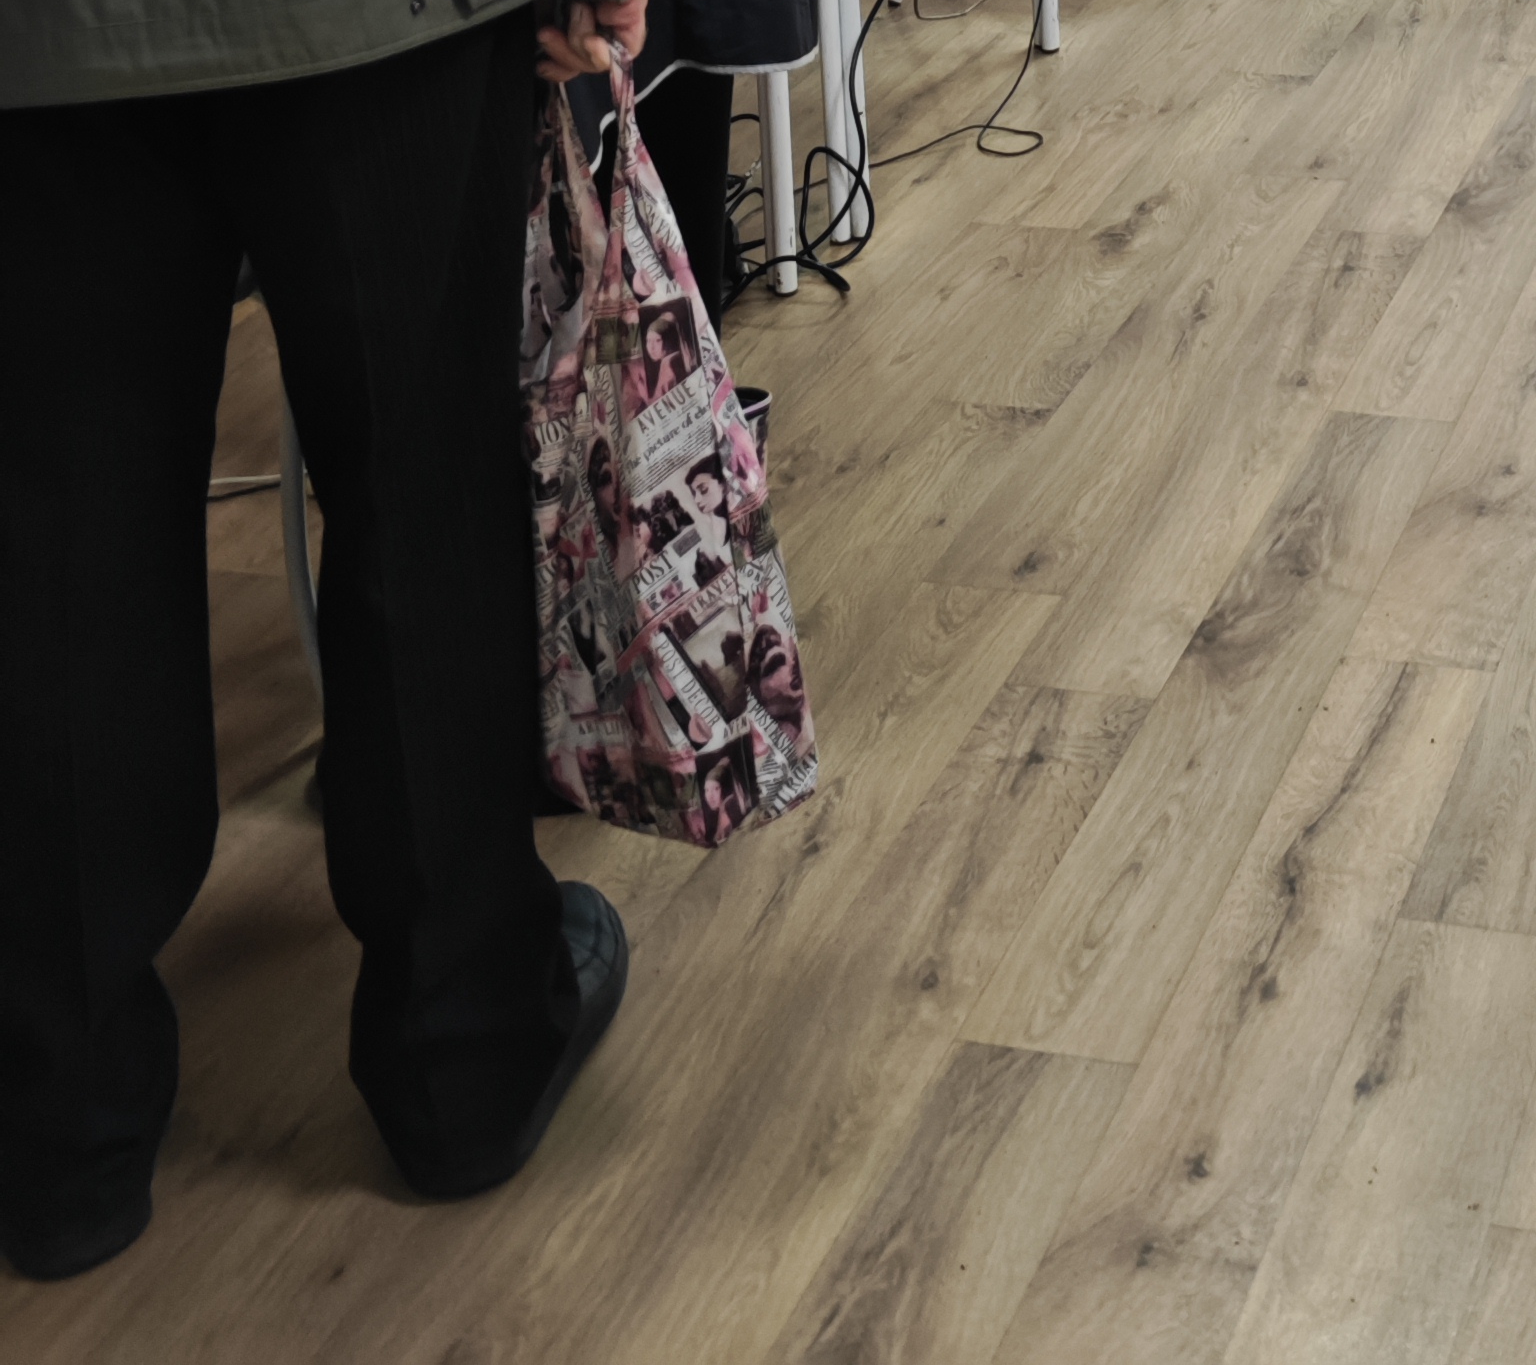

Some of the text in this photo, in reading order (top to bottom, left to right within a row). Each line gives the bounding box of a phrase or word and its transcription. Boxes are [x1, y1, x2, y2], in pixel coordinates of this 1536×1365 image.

[636, 380, 697, 434] AVENUE
[631, 550, 675, 596] POST
[655, 639, 721, 727] POST DECOR
